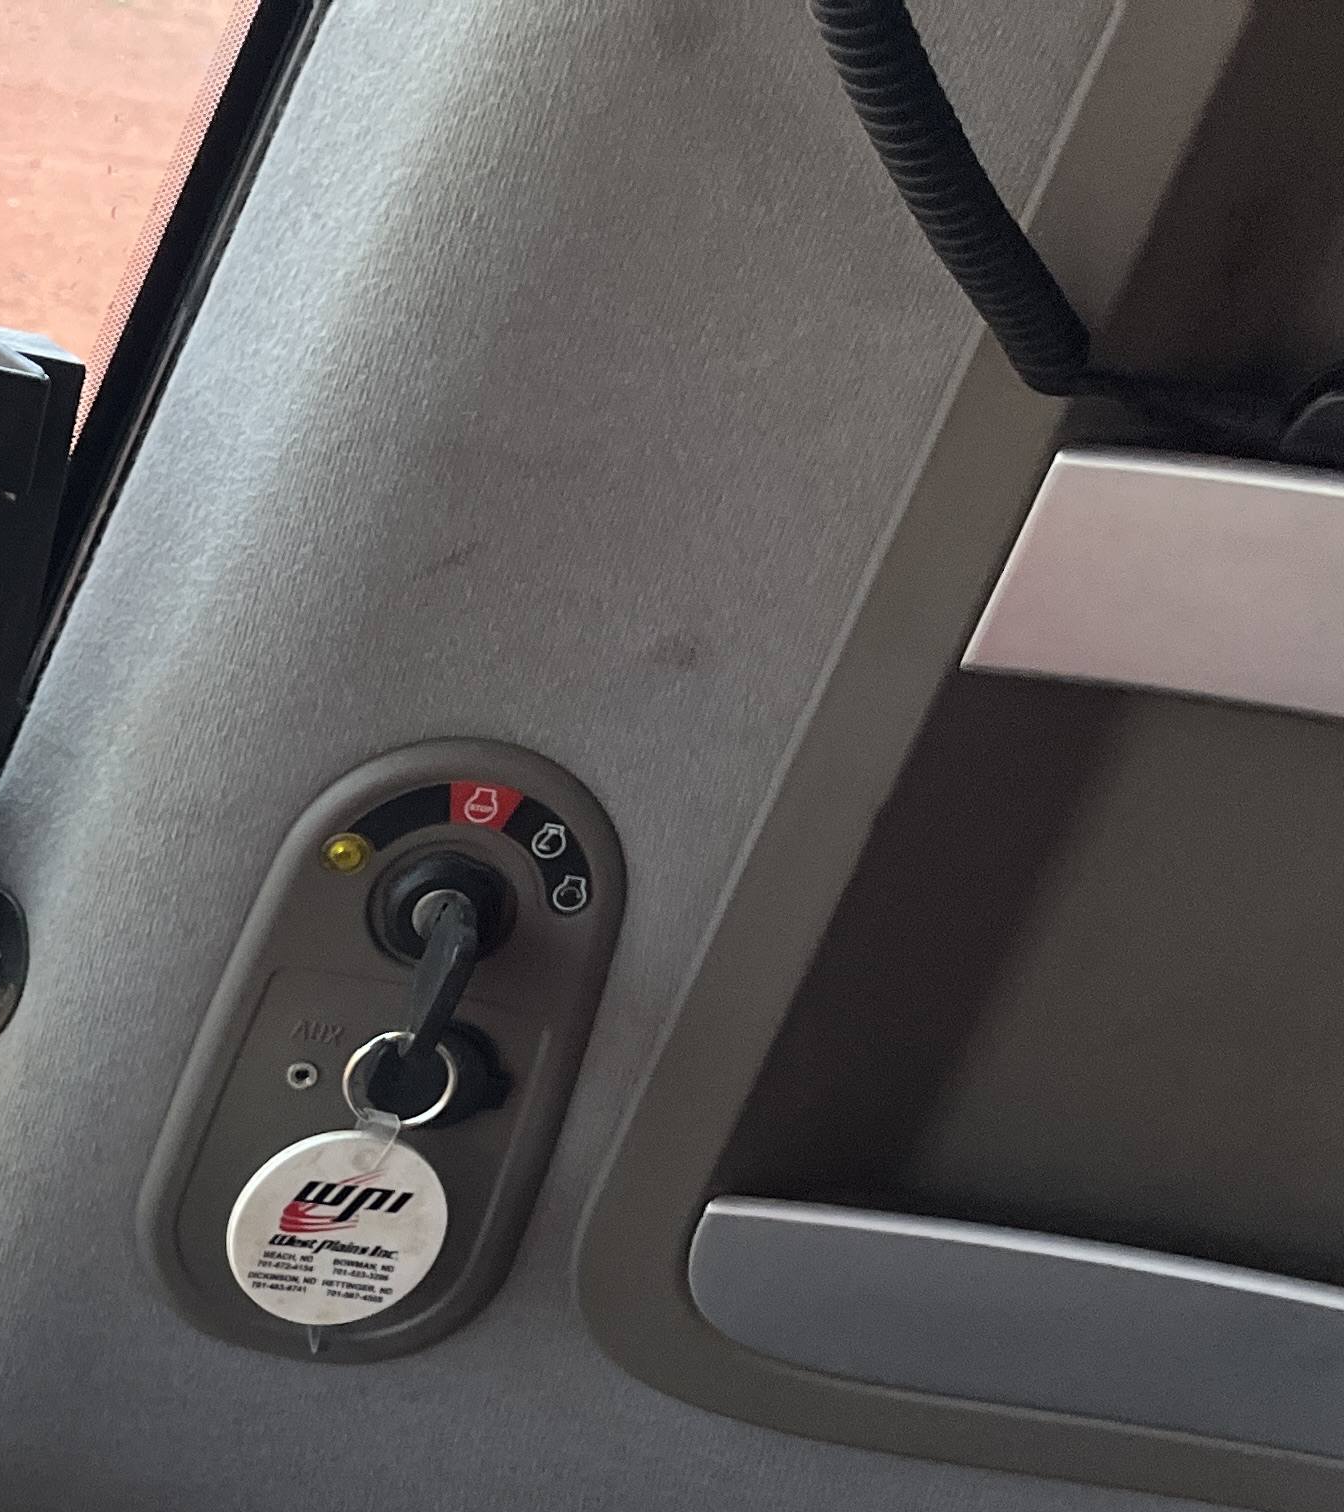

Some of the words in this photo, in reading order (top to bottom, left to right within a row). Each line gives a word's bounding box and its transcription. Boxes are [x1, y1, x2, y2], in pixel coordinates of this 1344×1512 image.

[269, 1234, 317, 1247] West
[314, 1239, 370, 1254] Plains
[300, 1254, 314, 1263] ND
[380, 1263, 395, 1273] ND
[302, 1277, 317, 1286] ND
[378, 1286, 394, 1295] ND
